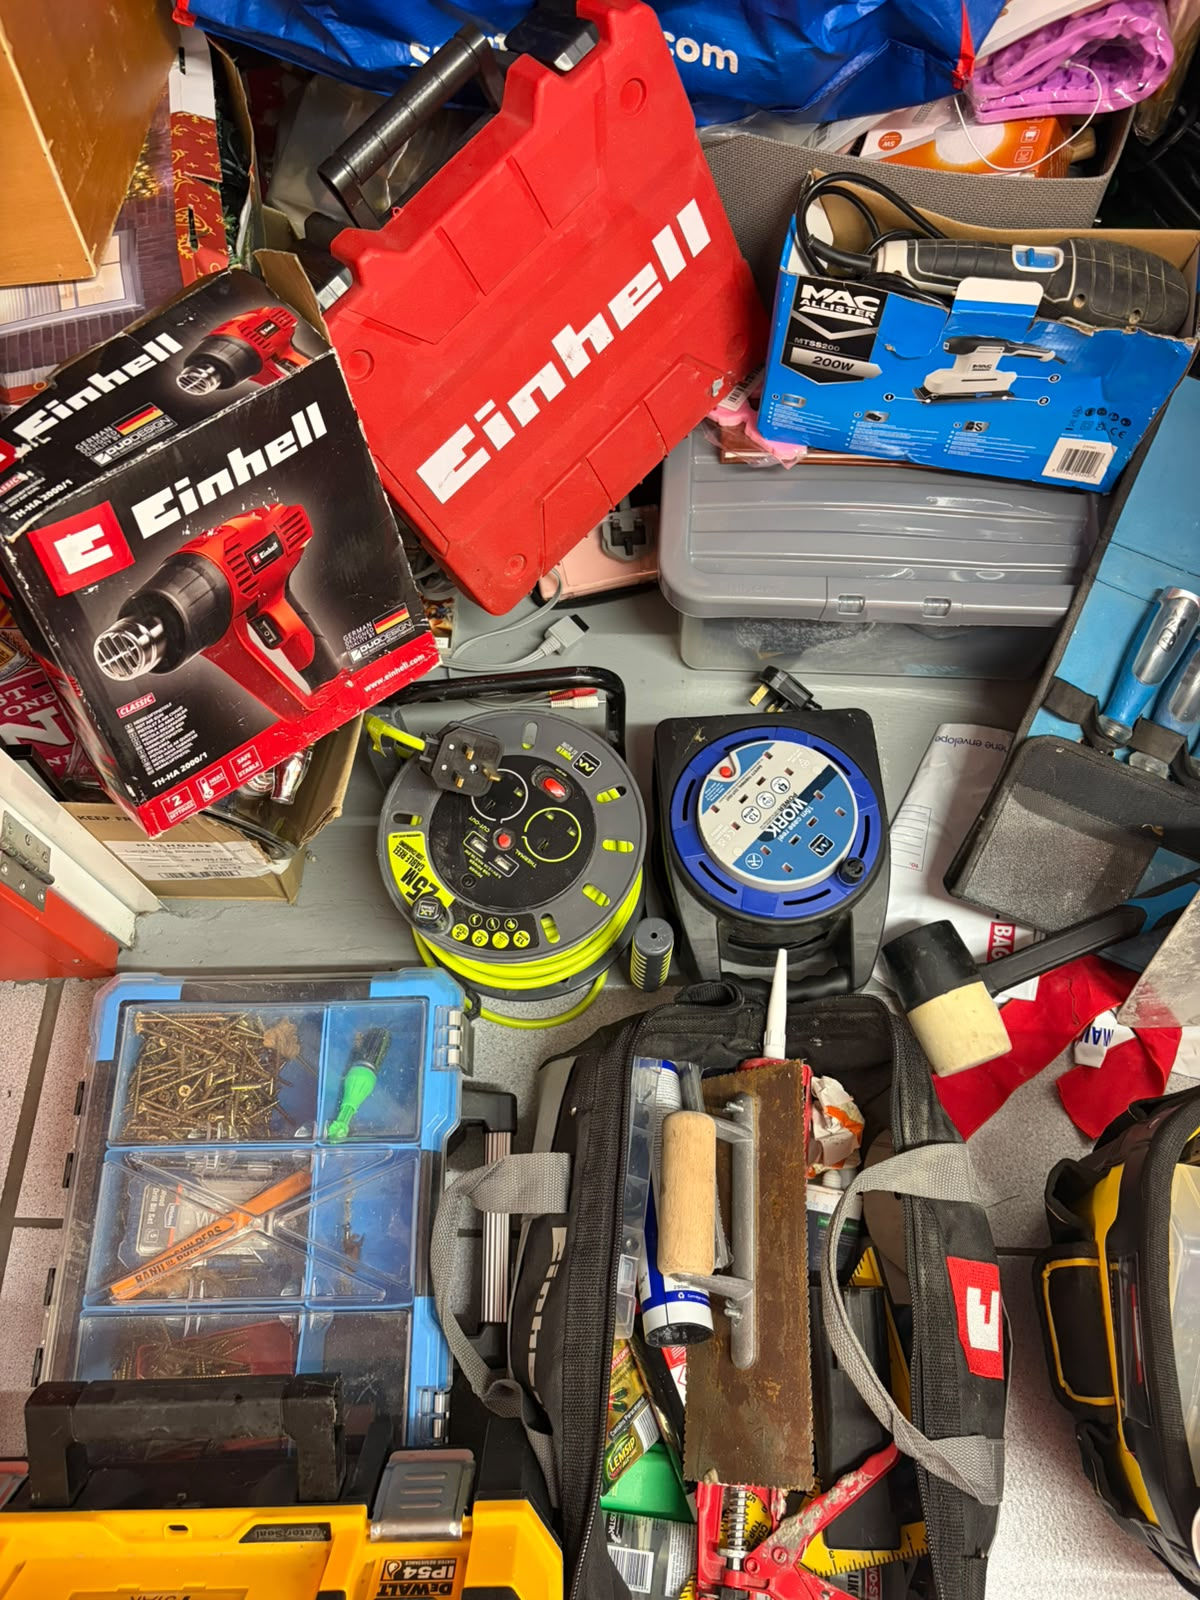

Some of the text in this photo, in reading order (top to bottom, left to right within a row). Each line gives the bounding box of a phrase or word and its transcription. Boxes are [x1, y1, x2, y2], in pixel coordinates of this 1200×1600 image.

[800, 284, 880, 311] MAC
[800, 298, 876, 320] ALLISTER
[416, 198, 711, 504] Einhell
[812, 355, 854, 372] 200W
[12, 332, 183, 439] Einhell
[74, 425, 113, 452] GERMAN
[131, 402, 328, 539] Einhell
[363, 654, 425, 692] www.einhell.com
[119, 694, 154, 717] CLASSIC
[934, 735, 982, 748] envelope
[152, 769, 180, 788] TH-HA
[179, 752, 209, 771] 2000/1
[776, 792, 798, 811] POWER
[766, 798, 808, 838] WORK
[392, 845, 425, 872] CABLE REEL
[608, 1437, 636, 1472] LEMSIP
[402, 1566, 454, 1579] IP54
